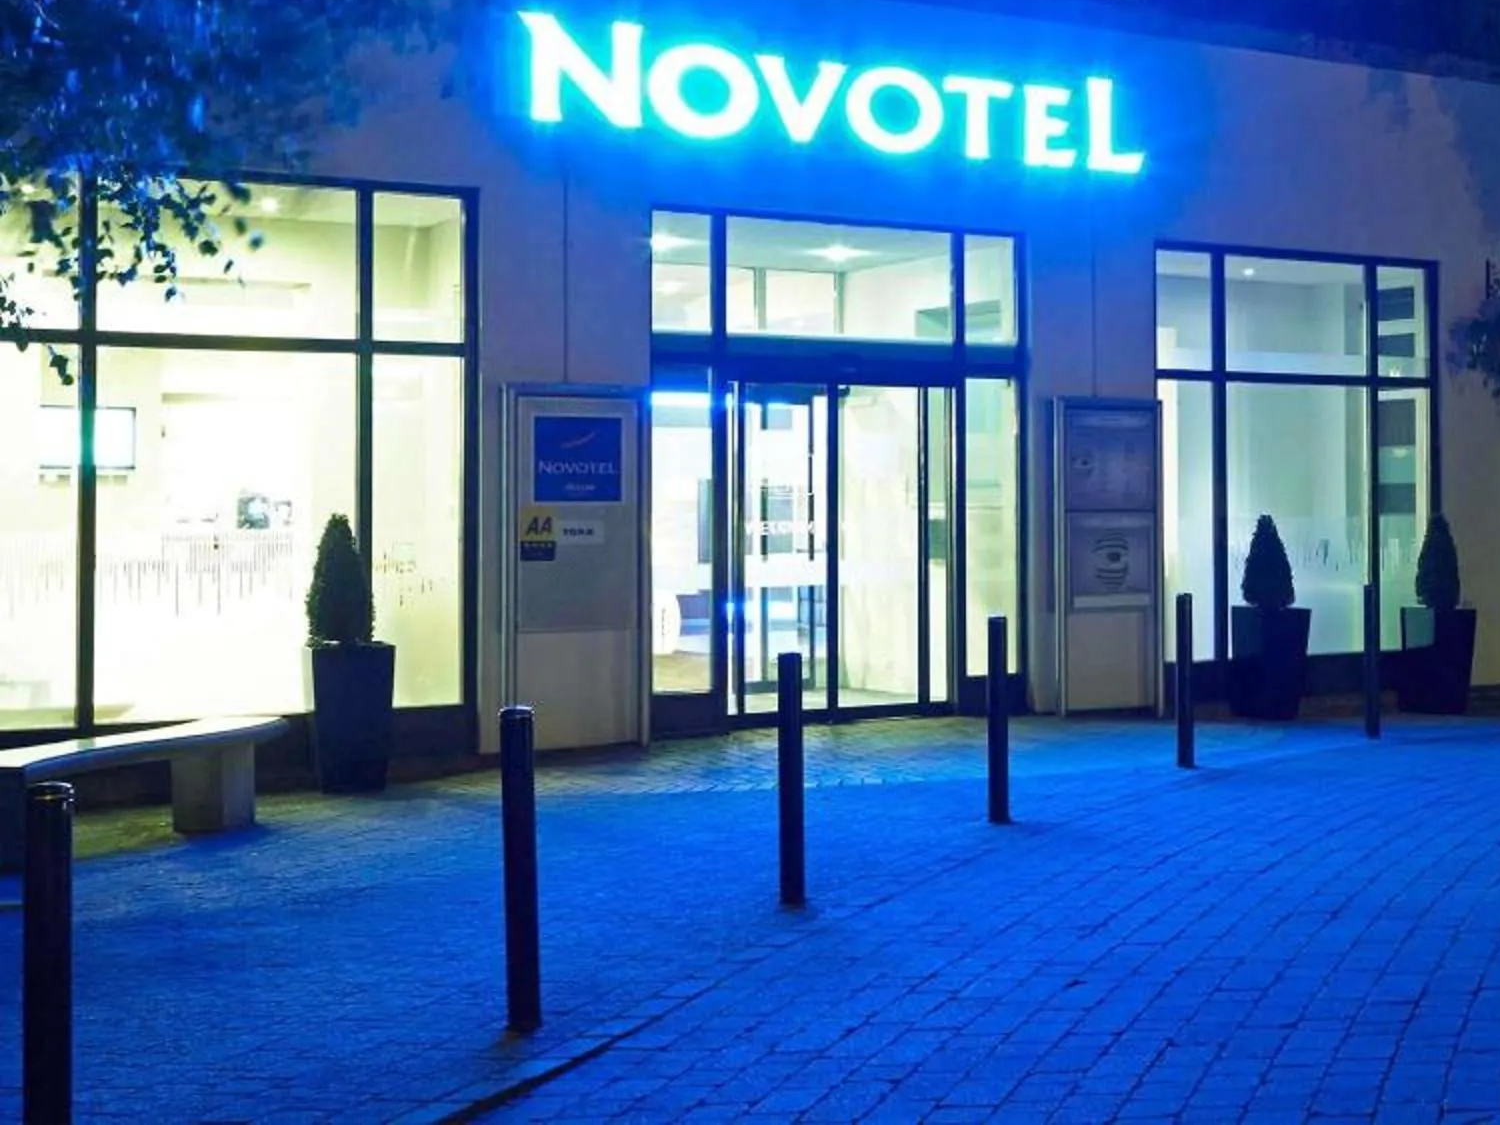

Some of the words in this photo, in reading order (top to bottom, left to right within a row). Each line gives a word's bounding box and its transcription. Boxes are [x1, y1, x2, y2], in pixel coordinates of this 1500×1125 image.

[517, 10, 1145, 174] NOVOTEL
[538, 460, 616, 475] NOVOTEL
[525, 516, 553, 536] AA
